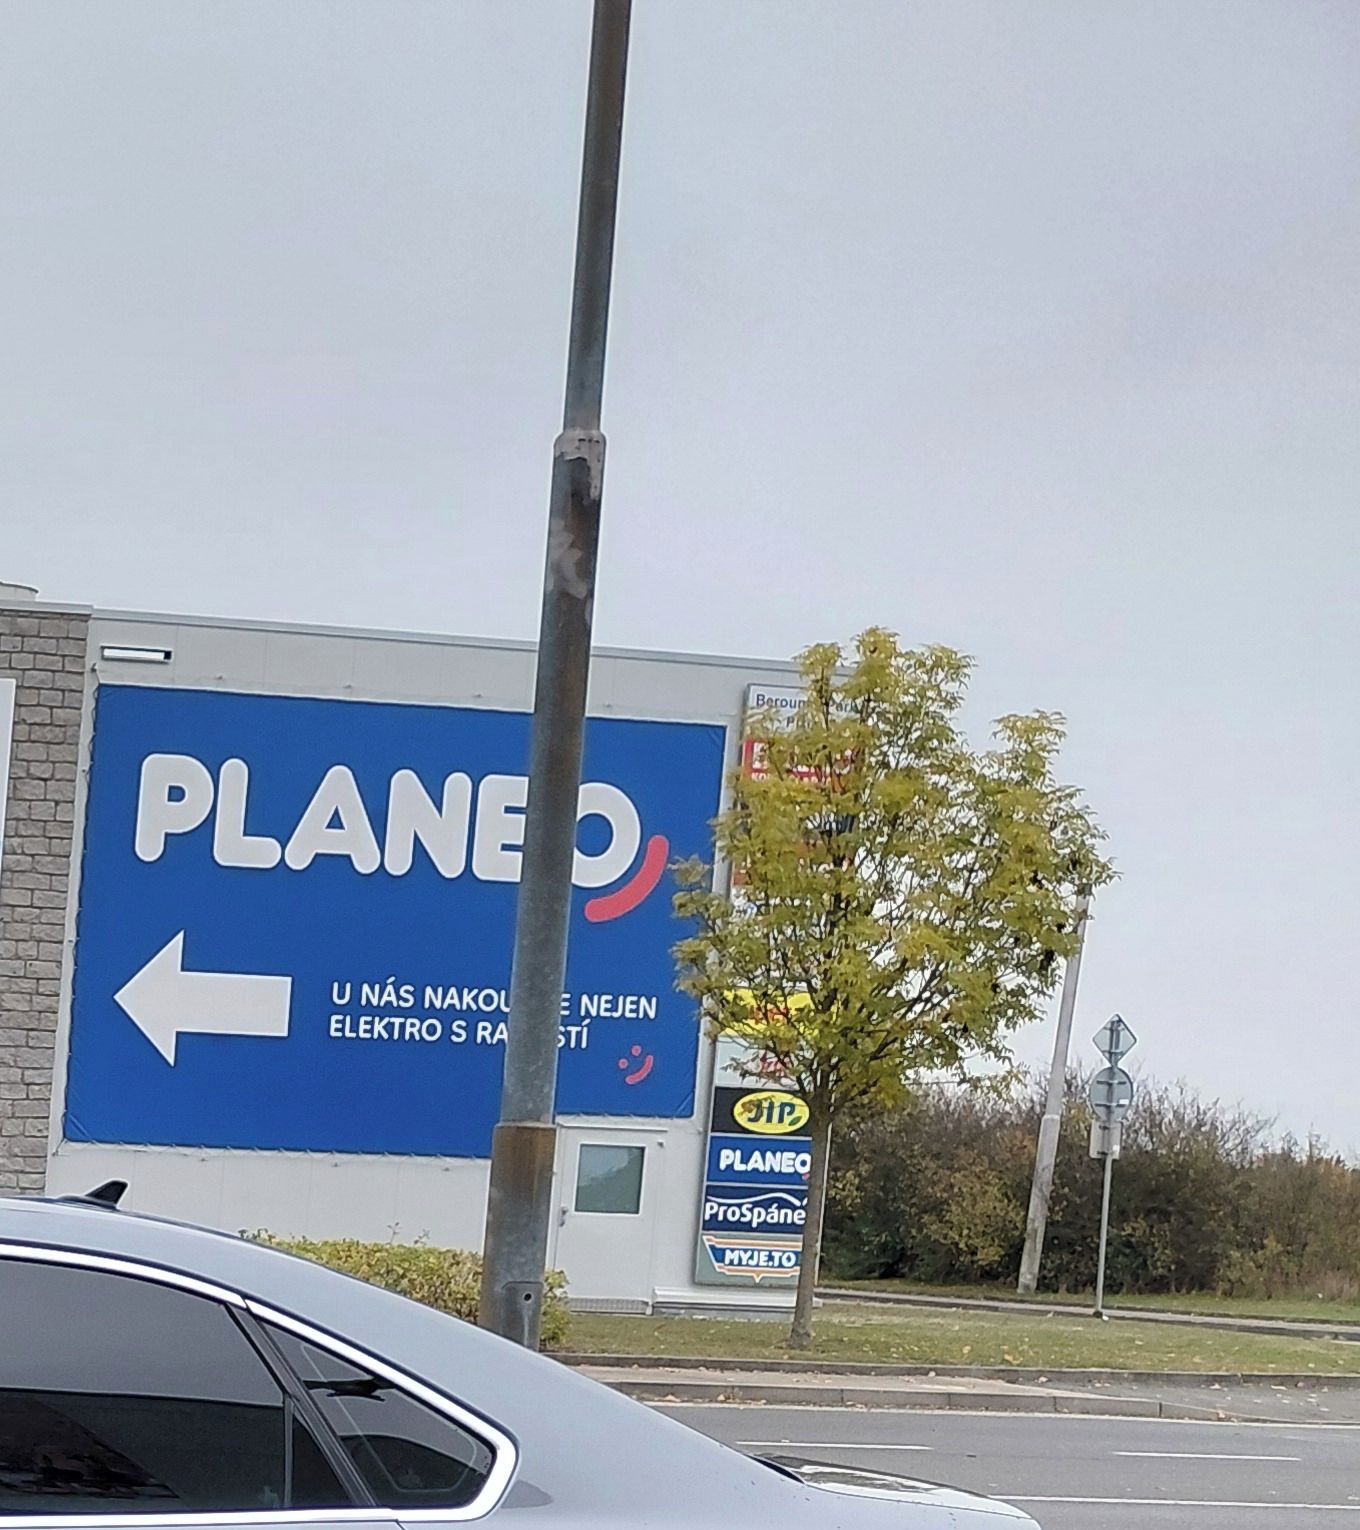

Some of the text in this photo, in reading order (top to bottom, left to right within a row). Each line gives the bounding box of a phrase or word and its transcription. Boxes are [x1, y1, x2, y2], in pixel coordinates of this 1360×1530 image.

[134, 752, 641, 889] PLANEO
[332, 981, 351, 1006] U
[360, 976, 415, 1010] NÁS
[579, 993, 657, 1020] NEJEN
[329, 1014, 443, 1042] ELEKTRO
[450, 1020, 468, 1044] S
[747, 1099, 796, 1124] JIP
[719, 1148, 811, 1174] PLANEO
[704, 1202, 807, 1228] ProSpáne
[724, 1249, 797, 1267] MYJE.TO
